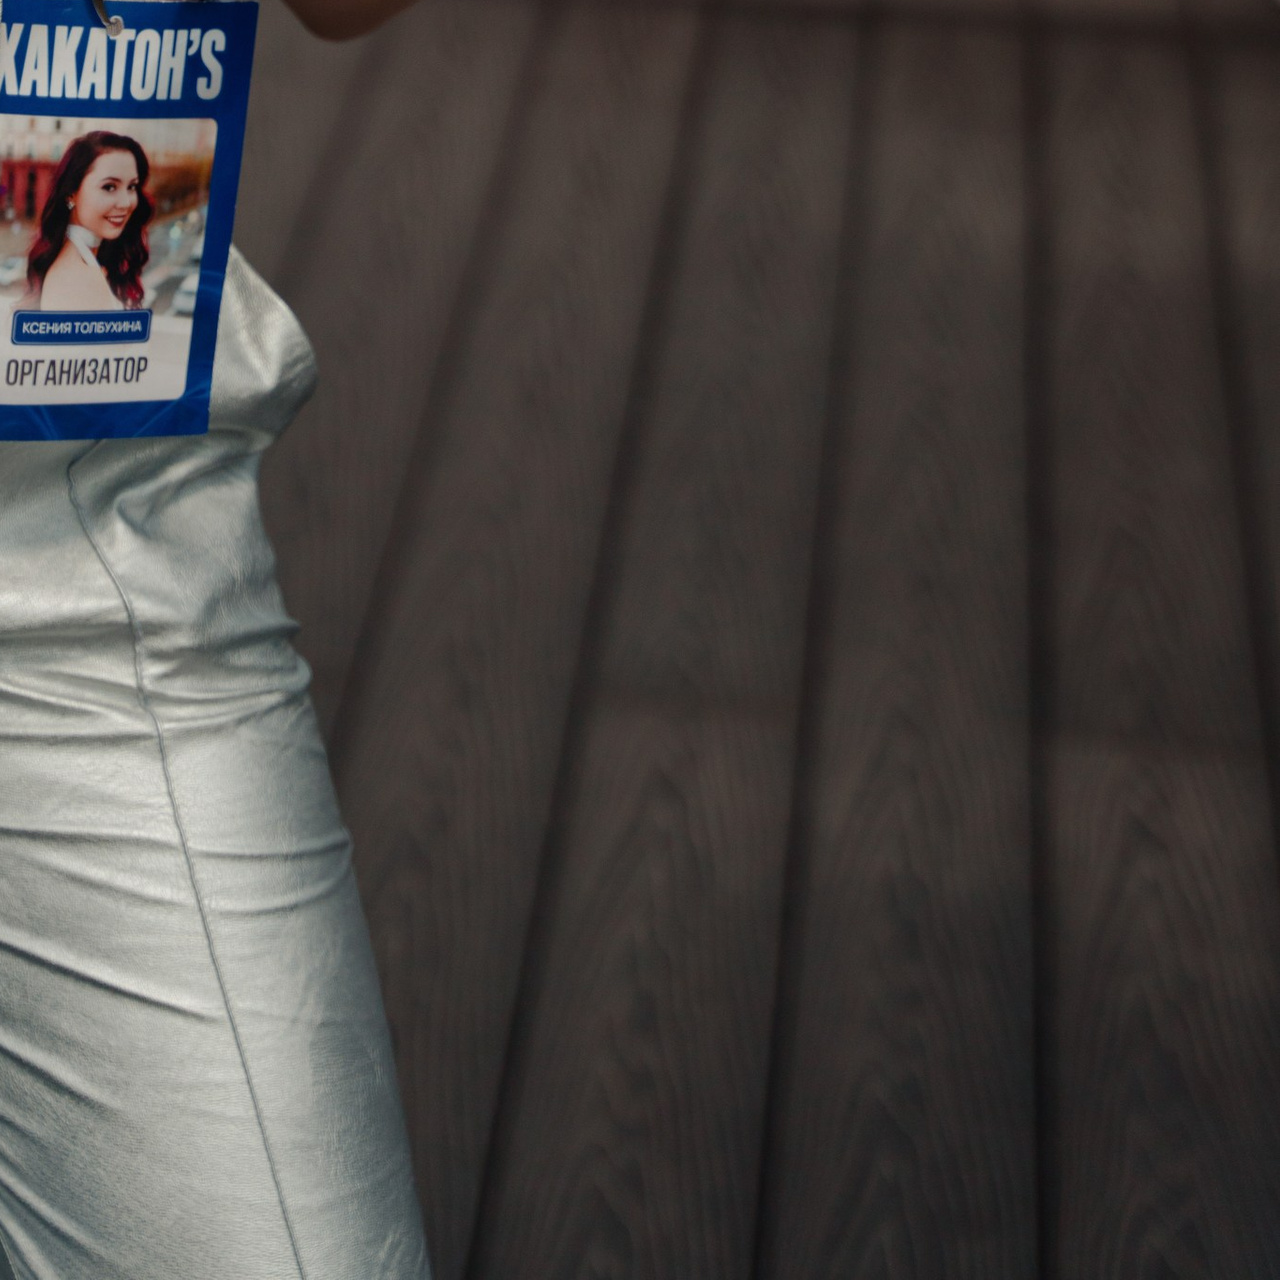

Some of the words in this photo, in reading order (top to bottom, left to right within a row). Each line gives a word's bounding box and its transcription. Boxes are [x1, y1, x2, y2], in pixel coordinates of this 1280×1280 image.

[22, 321, 71, 335] КСЕНИЯ
[74, 320, 142, 334] ТОЛБУХИНА
[5, 357, 148, 386] ОРГАНИЗАТОР
